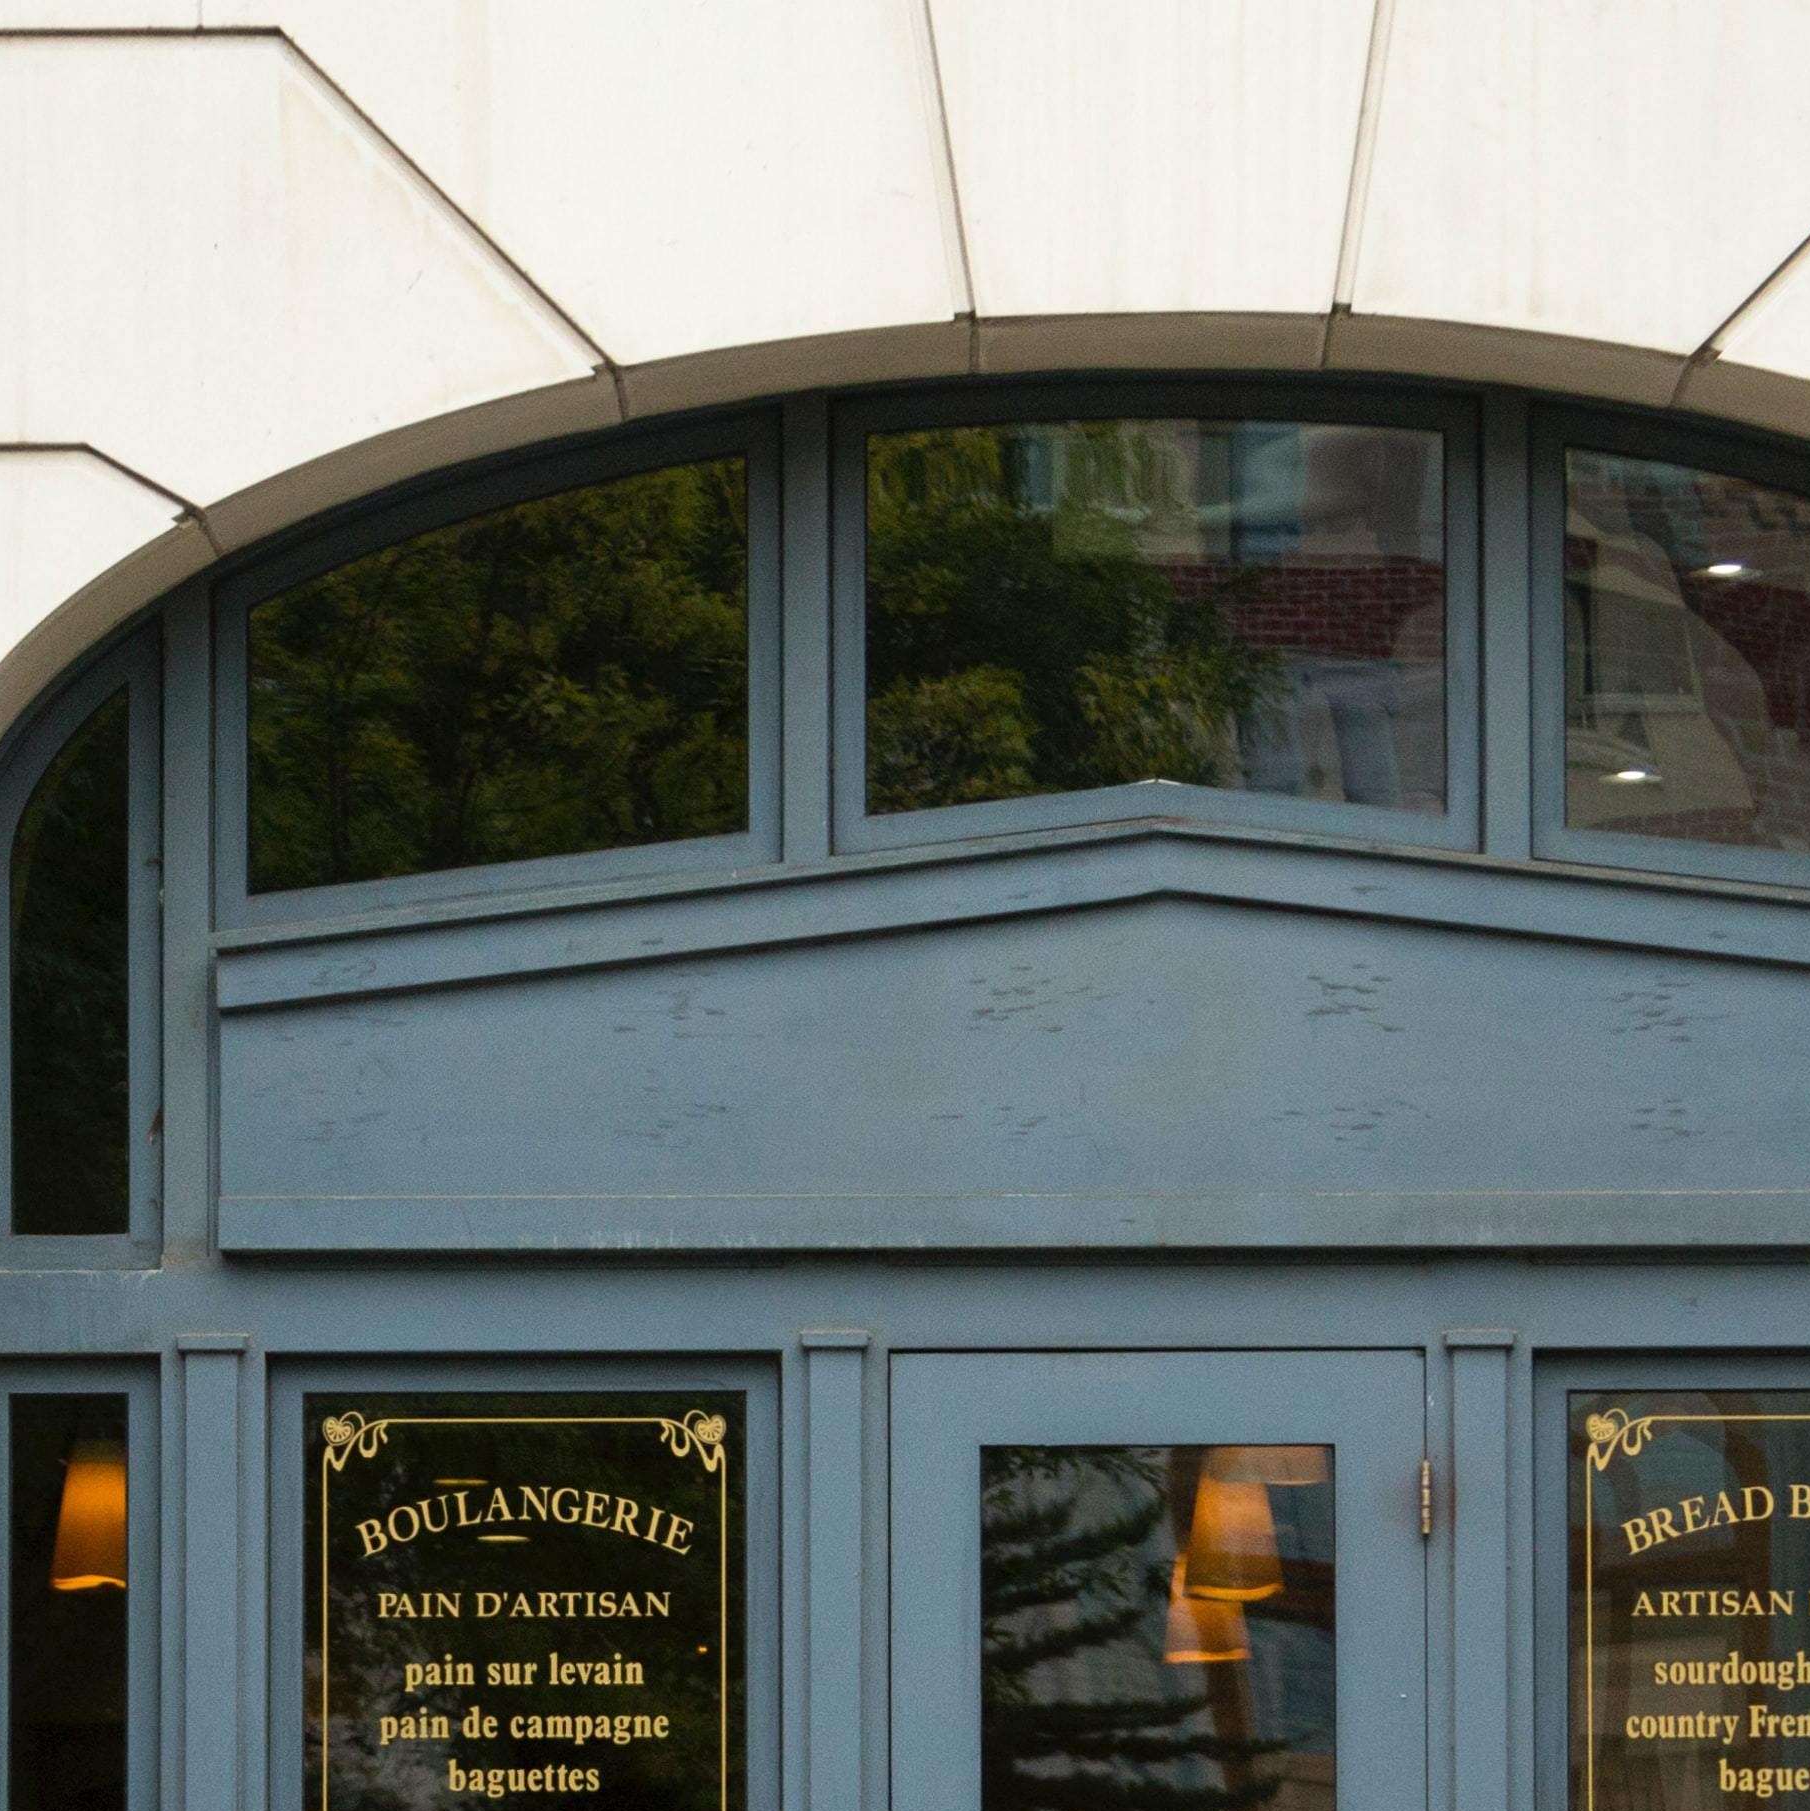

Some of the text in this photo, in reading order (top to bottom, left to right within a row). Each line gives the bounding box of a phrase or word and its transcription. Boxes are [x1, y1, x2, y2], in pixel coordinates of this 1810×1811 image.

[356, 1485, 694, 1557] BOULANGERIE
[1621, 1485, 1775, 1555] BREAD
[379, 1591, 670, 1618] PAIN D'ARTISAN
[1632, 1590, 1793, 1617] ARTISAN
[404, 1651, 644, 1693] pain sur levain
[379, 1705, 670, 1746] pain de campagne
[1625, 1711, 1739, 1745] country
[447, 1758, 600, 1799] baguettes
